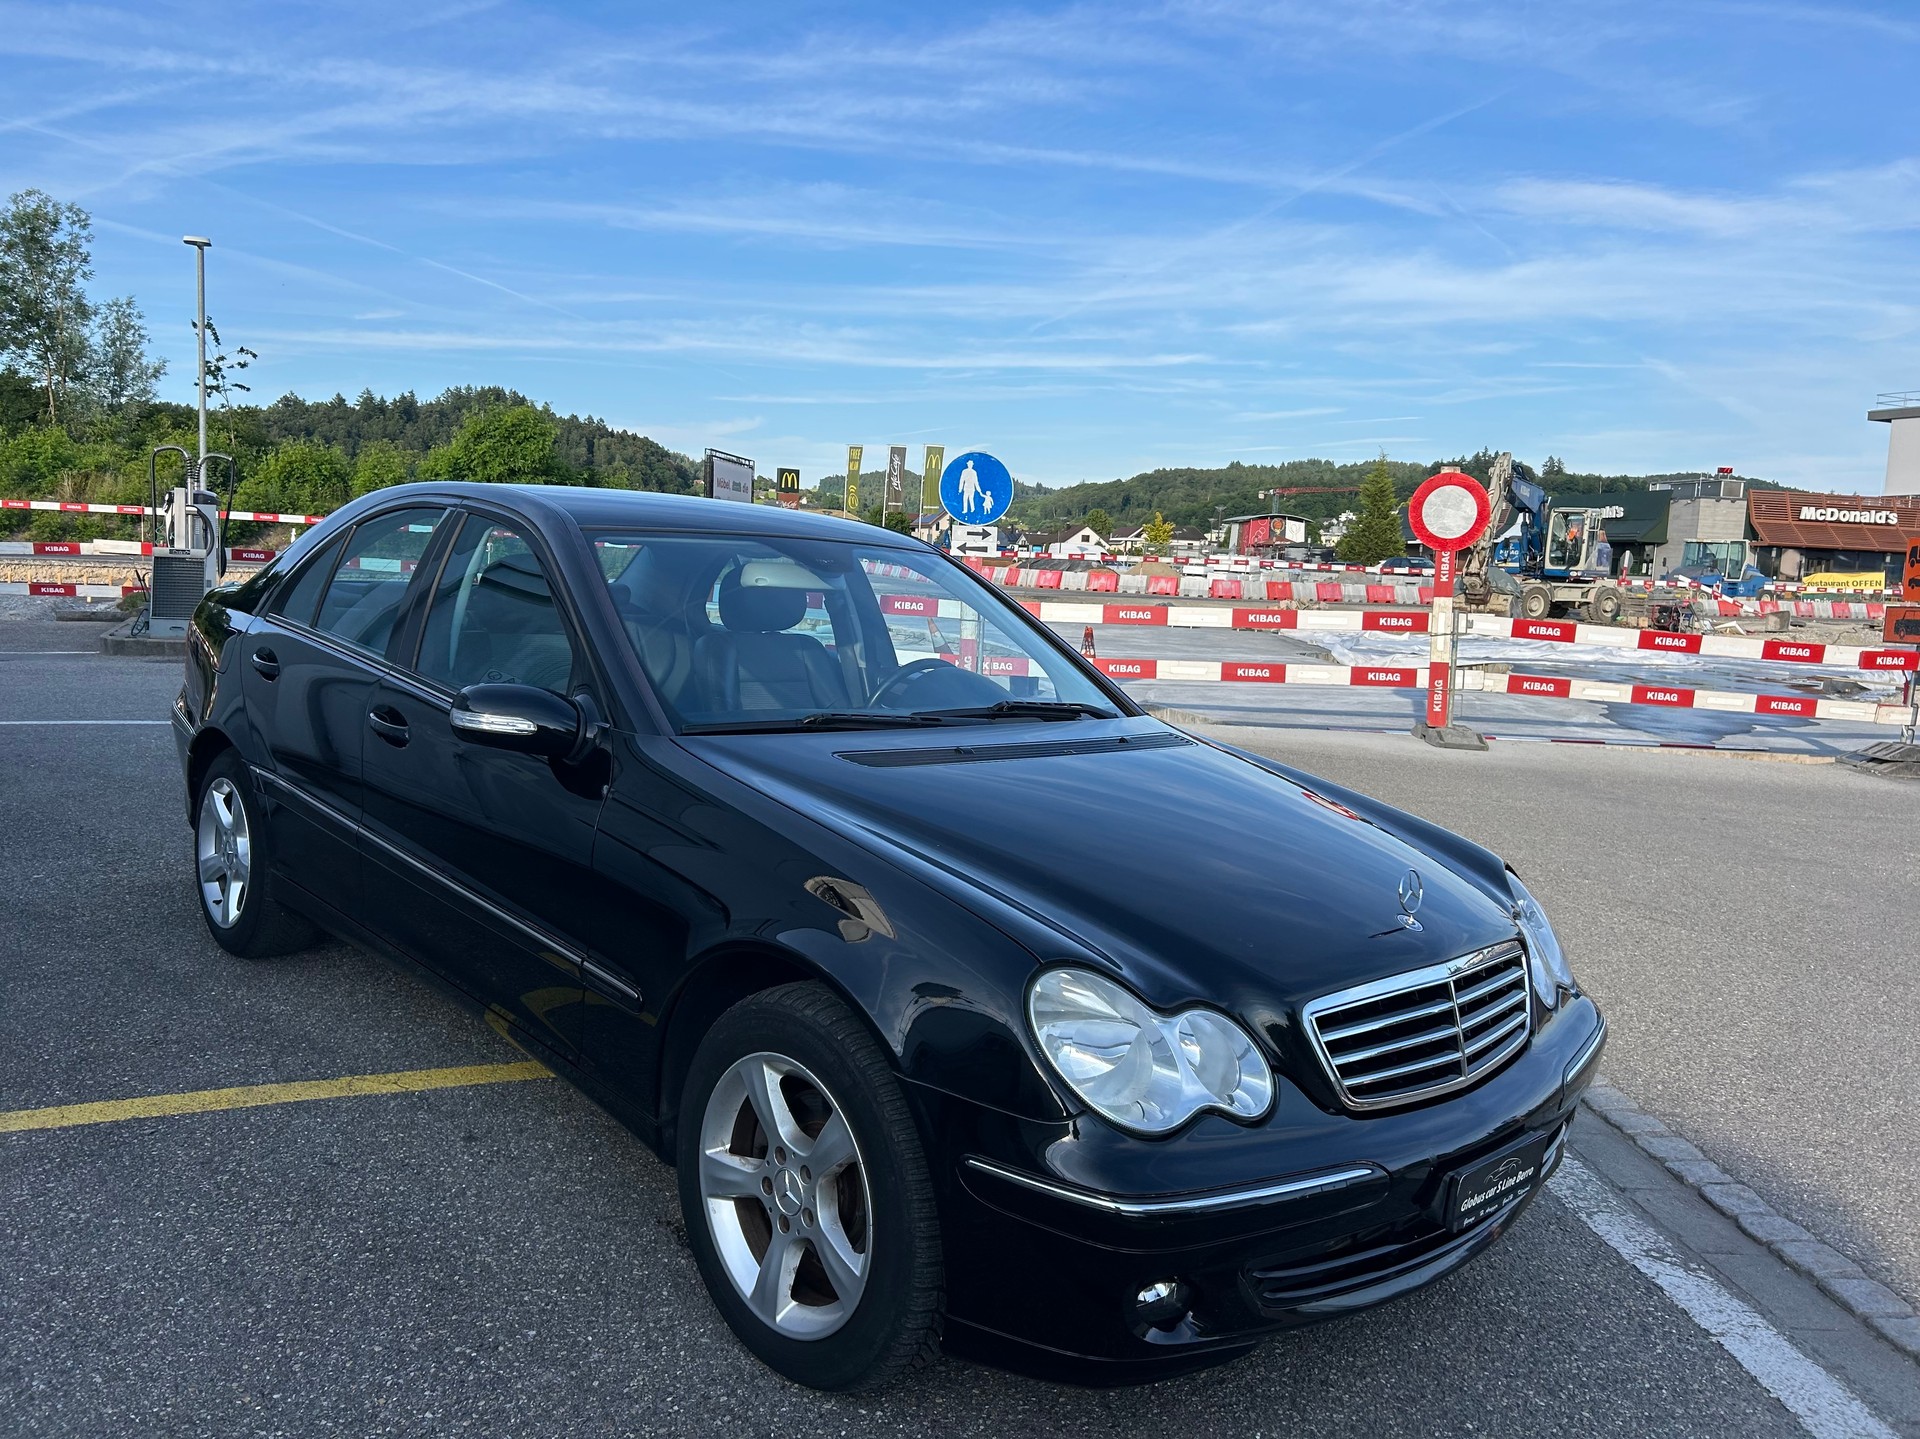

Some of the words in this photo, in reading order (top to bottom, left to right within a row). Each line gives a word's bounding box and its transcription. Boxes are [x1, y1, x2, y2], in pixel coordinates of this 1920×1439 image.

[1800, 506, 1898, 524] McDonald's
[1440, 551, 1450, 582] KIBAG
[895, 601, 924, 611] KIBAG
[1119, 610, 1151, 620] KIBAG
[1248, 614, 1281, 623] KIBAG
[1379, 617, 1412, 627] KIBAG
[1528, 625, 1560, 636] KIBAG
[1655, 636, 1687, 647] KIBAG
[1778, 646, 1810, 657] KIBAG
[1876, 656, 1905, 666] KIBAG
[1108, 664, 1141, 673] KIBAG
[1237, 668, 1270, 678] KIBAG
[1367, 672, 1401, 681] KIBAG
[1523, 681, 1554, 692] KIBAG
[1433, 679, 1443, 712] KIBAG
[1647, 691, 1678, 702] KIBAG
[1770, 701, 1802, 712] KIBAG
[1461, 1192, 1486, 1212] Globus
[1486, 1186, 1498, 1199] car
[1502, 1176, 1516, 1190] Line
